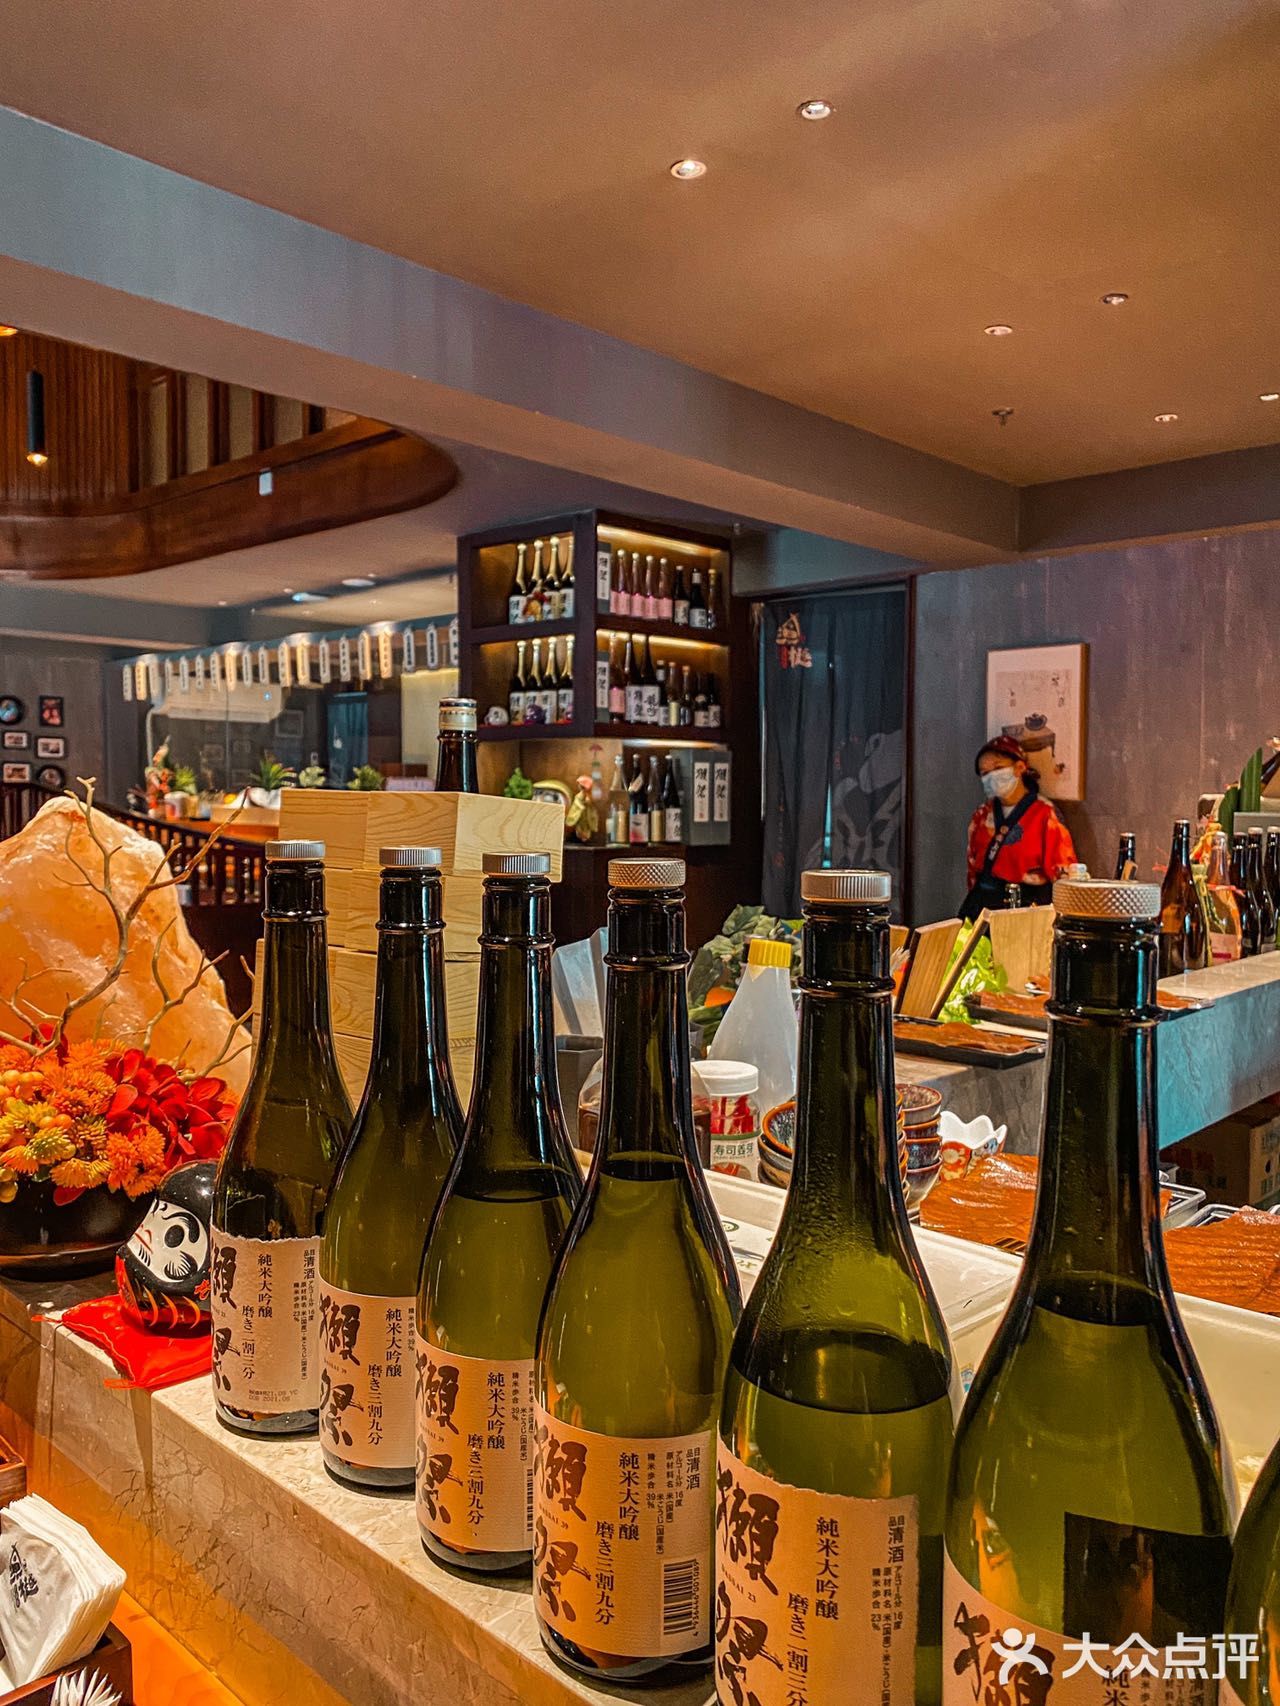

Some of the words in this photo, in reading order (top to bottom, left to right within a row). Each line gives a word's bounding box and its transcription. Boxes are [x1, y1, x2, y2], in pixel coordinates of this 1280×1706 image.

[257, 1253, 273, 1319] 純米大吟醸
[385, 1308, 402, 1378] 純米大吟醸
[367, 1363, 383, 1446] 磨き三割九分
[487, 1371, 505, 1450] 純米大吟醸
[466, 1433, 485, 1525] 磨き三割九分
[618, 1451, 640, 1541] 純米大吟醸
[647, 1453, 656, 1489] 精米歩合
[666, 1451, 674, 1488] 原材料名
[675, 1450, 683, 1487] アルコール分
[686, 1457, 700, 1490] 清酒
[594, 1520, 615, 1626] 磨き三割九分
[815, 1516, 840, 1620] 純米大吟醸
[887, 1526, 905, 1564] 清酒
[872, 1568, 881, 1609] 精米歩合
[883, 1567, 892, 1609] 原材料名
[786, 1591, 809, 1706] 磨き二割三分
